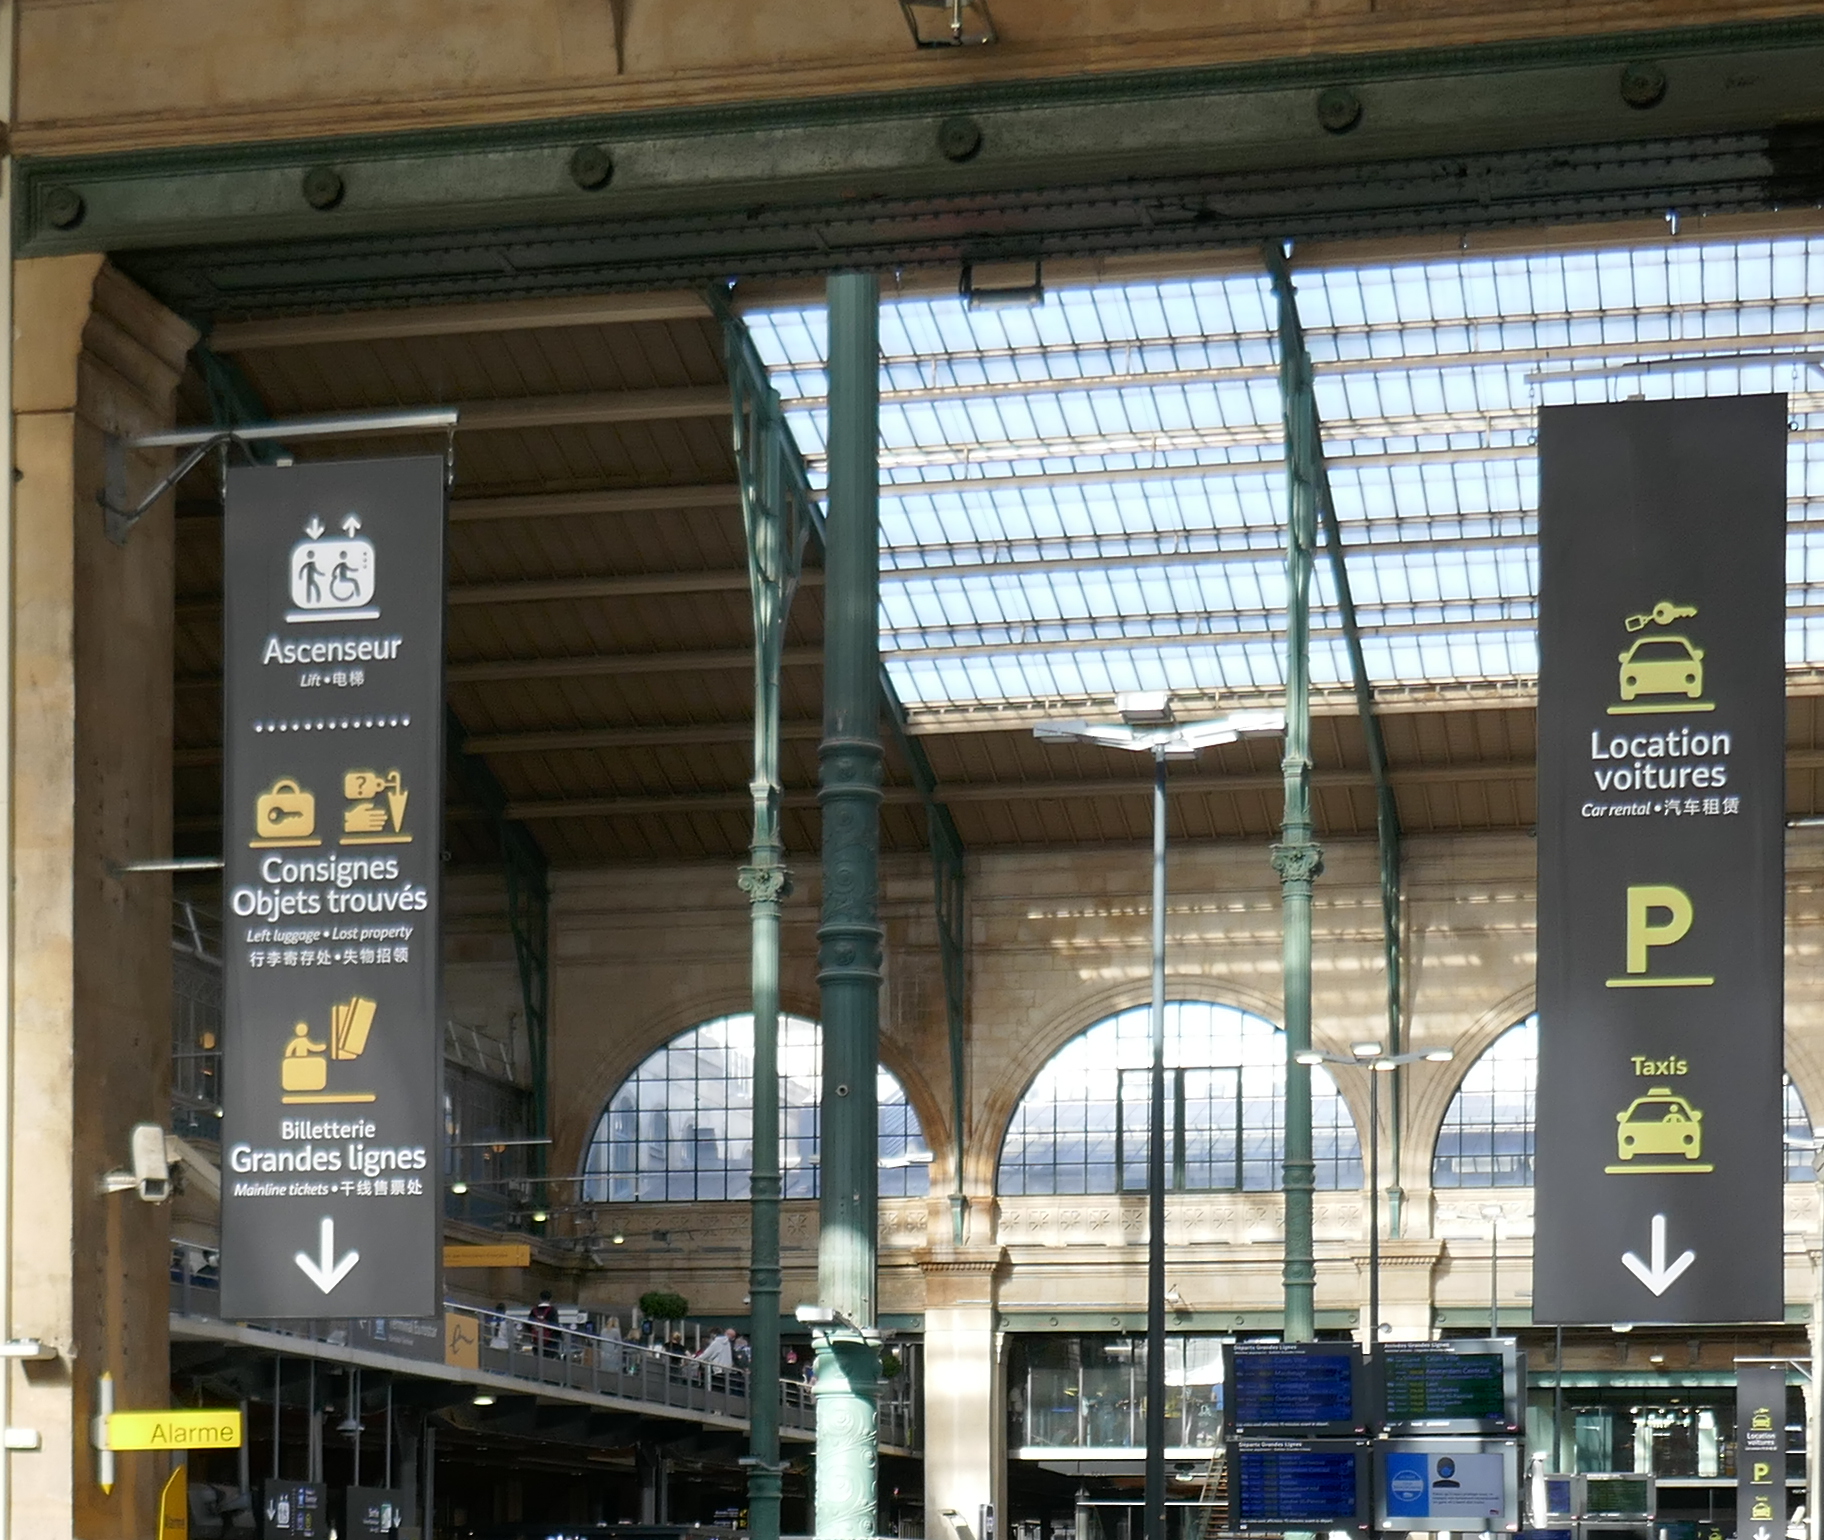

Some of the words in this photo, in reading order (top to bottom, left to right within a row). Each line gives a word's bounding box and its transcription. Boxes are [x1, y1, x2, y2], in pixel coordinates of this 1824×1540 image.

[263, 635, 403, 665] Ascenseur
[300, 674, 321, 687] Lift
[332, 672, 365, 687] 电梯
[1591, 728, 1731, 760] Location
[1594, 761, 1727, 792] voitures
[1581, 802, 1607, 818] Car
[1609, 801, 1651, 816] rental
[1664, 797, 1740, 816] 汽车租赁
[262, 856, 399, 887] Consignes
[232, 889, 321, 922] Objets
[327, 884, 428, 913] trouvés
[247, 929, 271, 943] Left
[273, 929, 321, 944] luggage
[332, 927, 357, 941] Lost
[359, 926, 414, 943] property
[1626, 885, 1694, 974] P
[249, 949, 332, 967] 行李寄存处
[343, 948, 409, 965] 失物招领
[1631, 1055, 1688, 1077] Taxis
[281, 1120, 376, 1140] Billetterie
[231, 1145, 342, 1173] Grandes
[348, 1144, 427, 1176] lignes
[234, 1182, 287, 1197] Mainline
[289, 1183, 329, 1196] tickets
[340, 1179, 424, 1197] 干线售票处
[151, 1423, 234, 1444] Alarme
[1754, 1463, 1770, 1481] P
